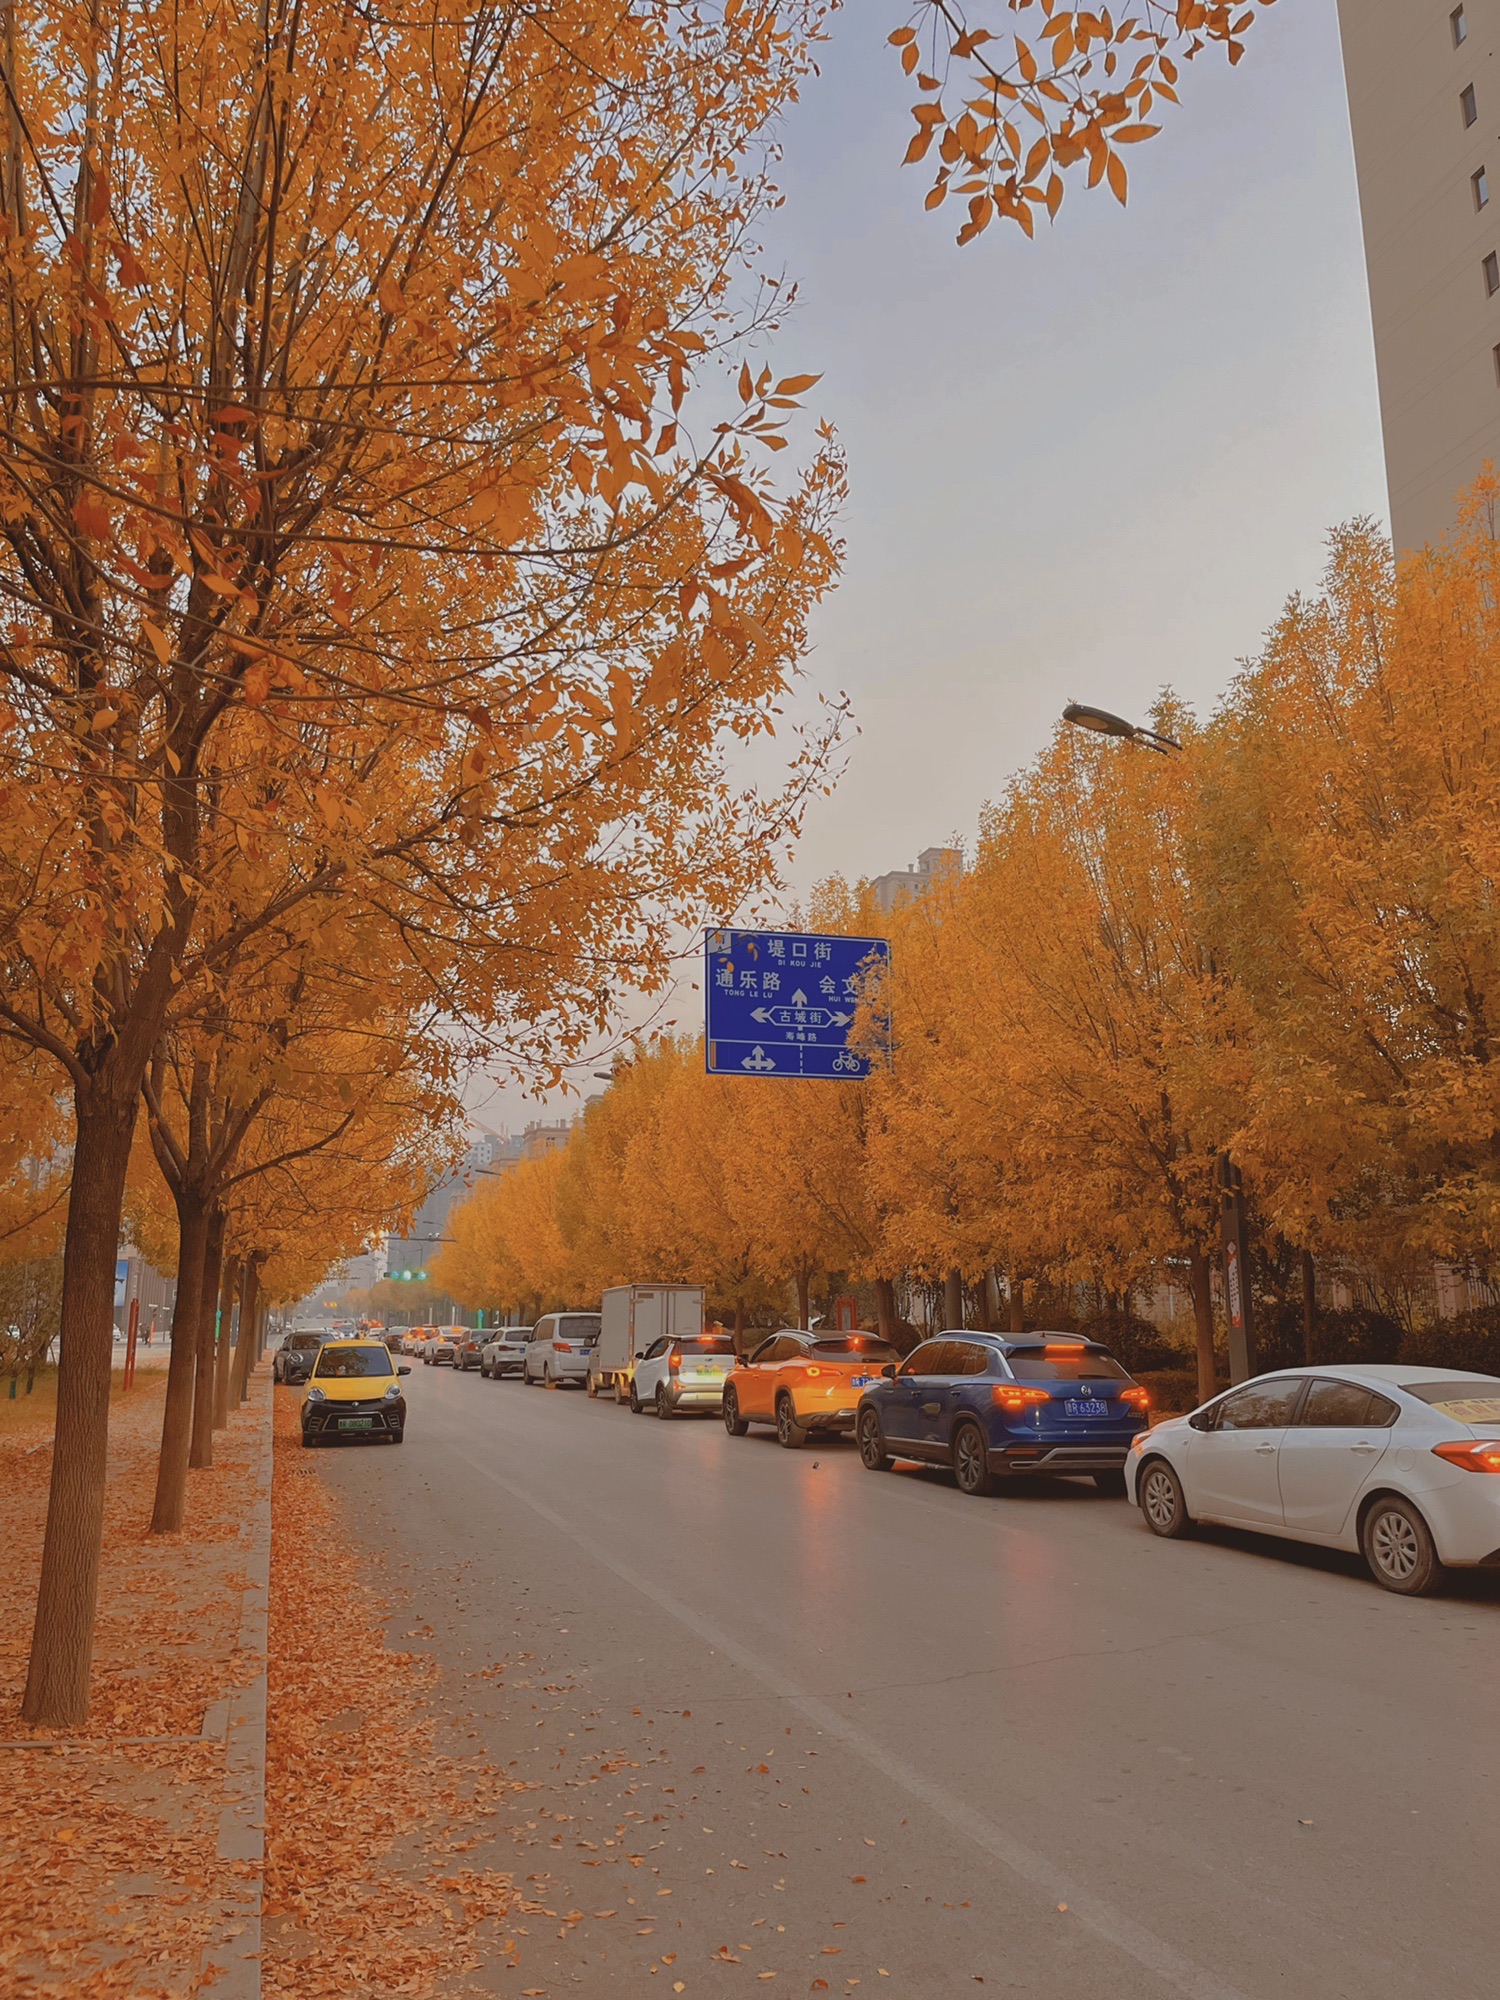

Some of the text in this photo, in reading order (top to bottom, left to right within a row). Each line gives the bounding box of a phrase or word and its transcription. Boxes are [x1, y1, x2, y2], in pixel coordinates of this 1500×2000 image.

[767, 939, 832, 961] 堤口街
[790, 960, 806, 968] KOU
[810, 961, 822, 969] JIE
[715, 968, 781, 991] 通乐路
[724, 989, 773, 999] TONG LE LU
[828, 995, 841, 1003] HUI
[779, 1010, 822, 1024] 古城街
